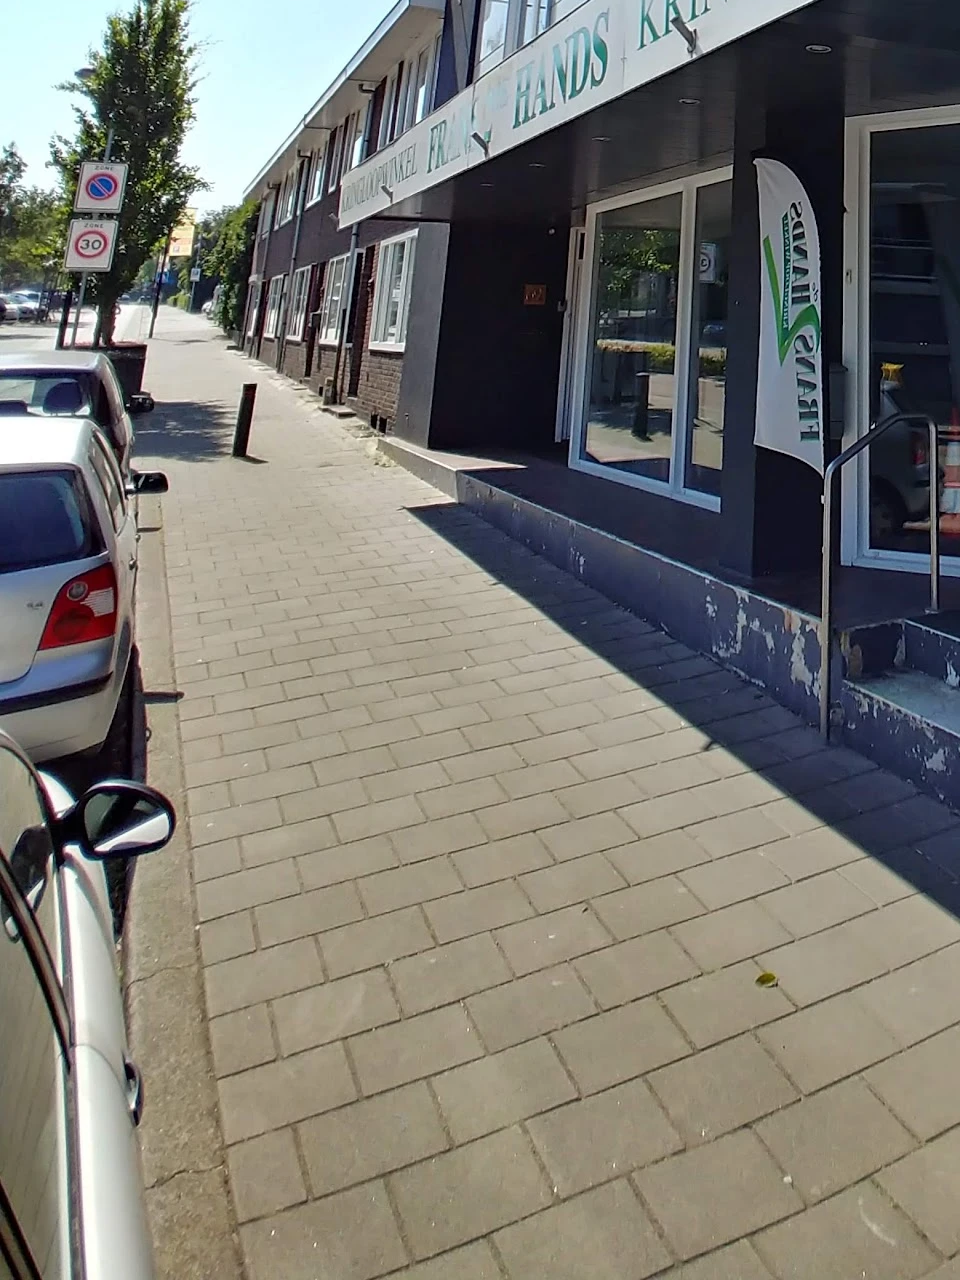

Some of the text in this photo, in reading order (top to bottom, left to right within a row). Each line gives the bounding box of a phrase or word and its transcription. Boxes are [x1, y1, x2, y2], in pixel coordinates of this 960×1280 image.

[342, 144, 418, 212] KRINGLOOPWINKEL
[512, 7, 610, 129] HANDS
[80, 239, 102, 250] 30
